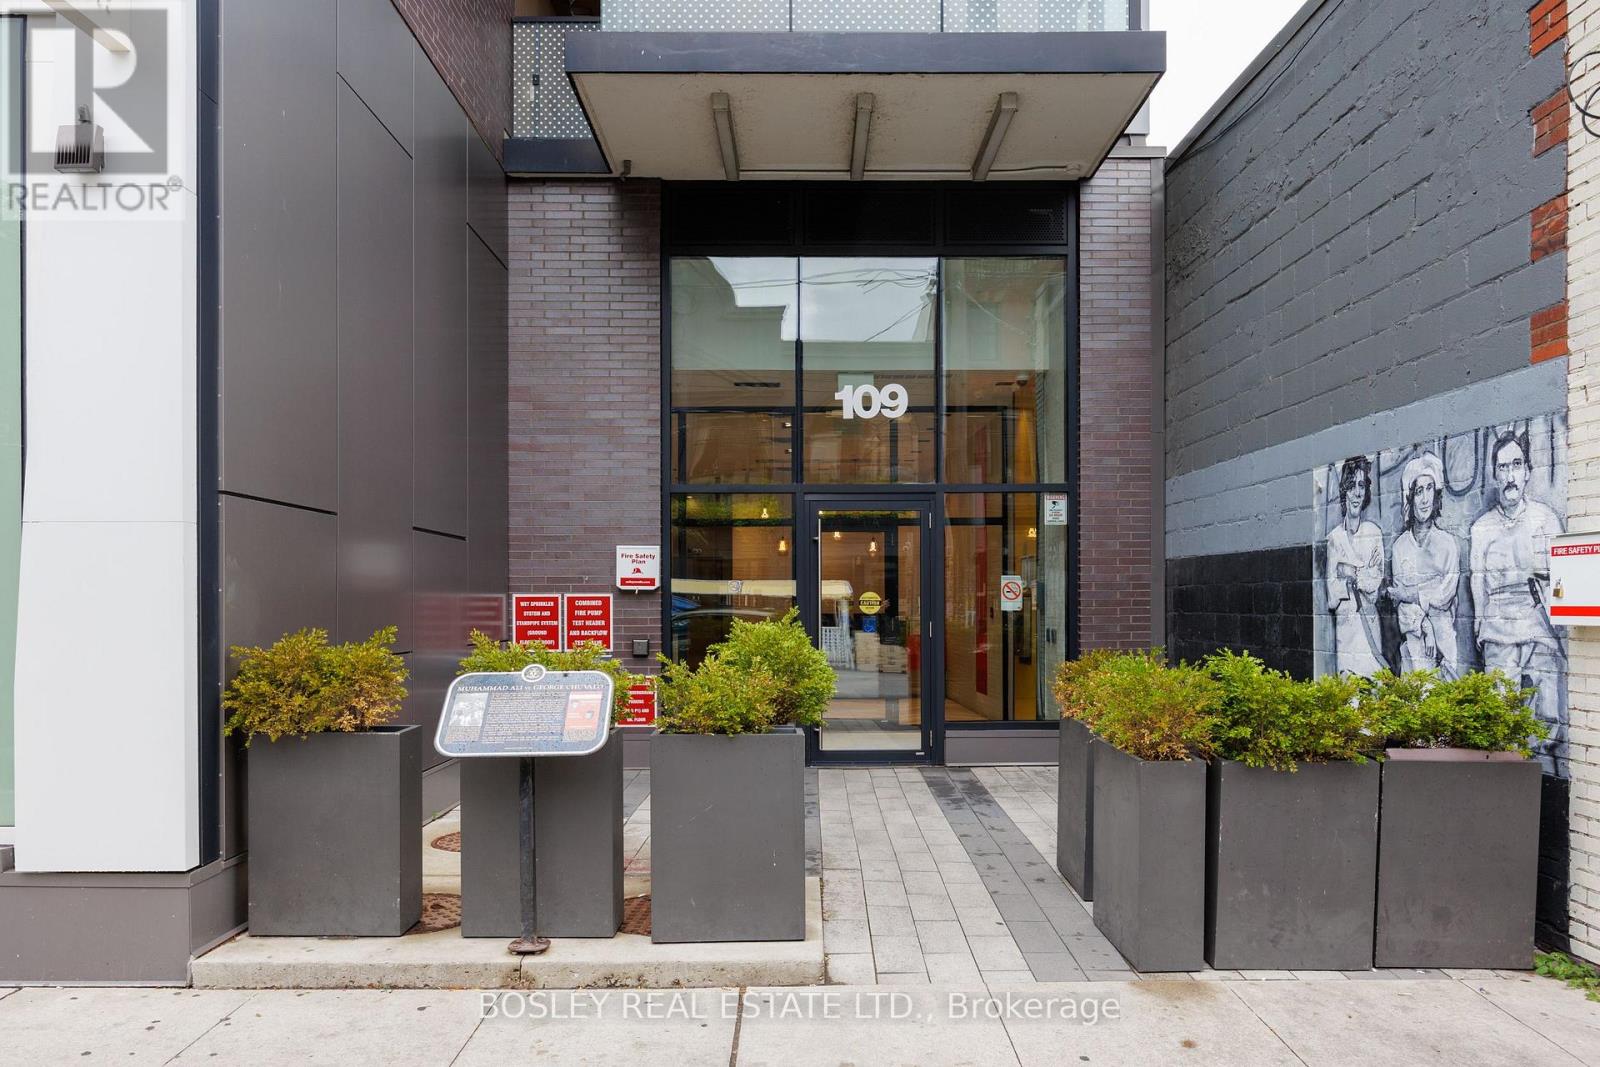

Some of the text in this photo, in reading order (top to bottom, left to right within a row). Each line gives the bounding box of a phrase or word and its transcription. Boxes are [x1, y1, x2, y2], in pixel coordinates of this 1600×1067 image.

[834, 383, 909, 420] 109
[1553, 547, 1568, 555] FIRE
[1568, 546, 1593, 554] SAFETY
